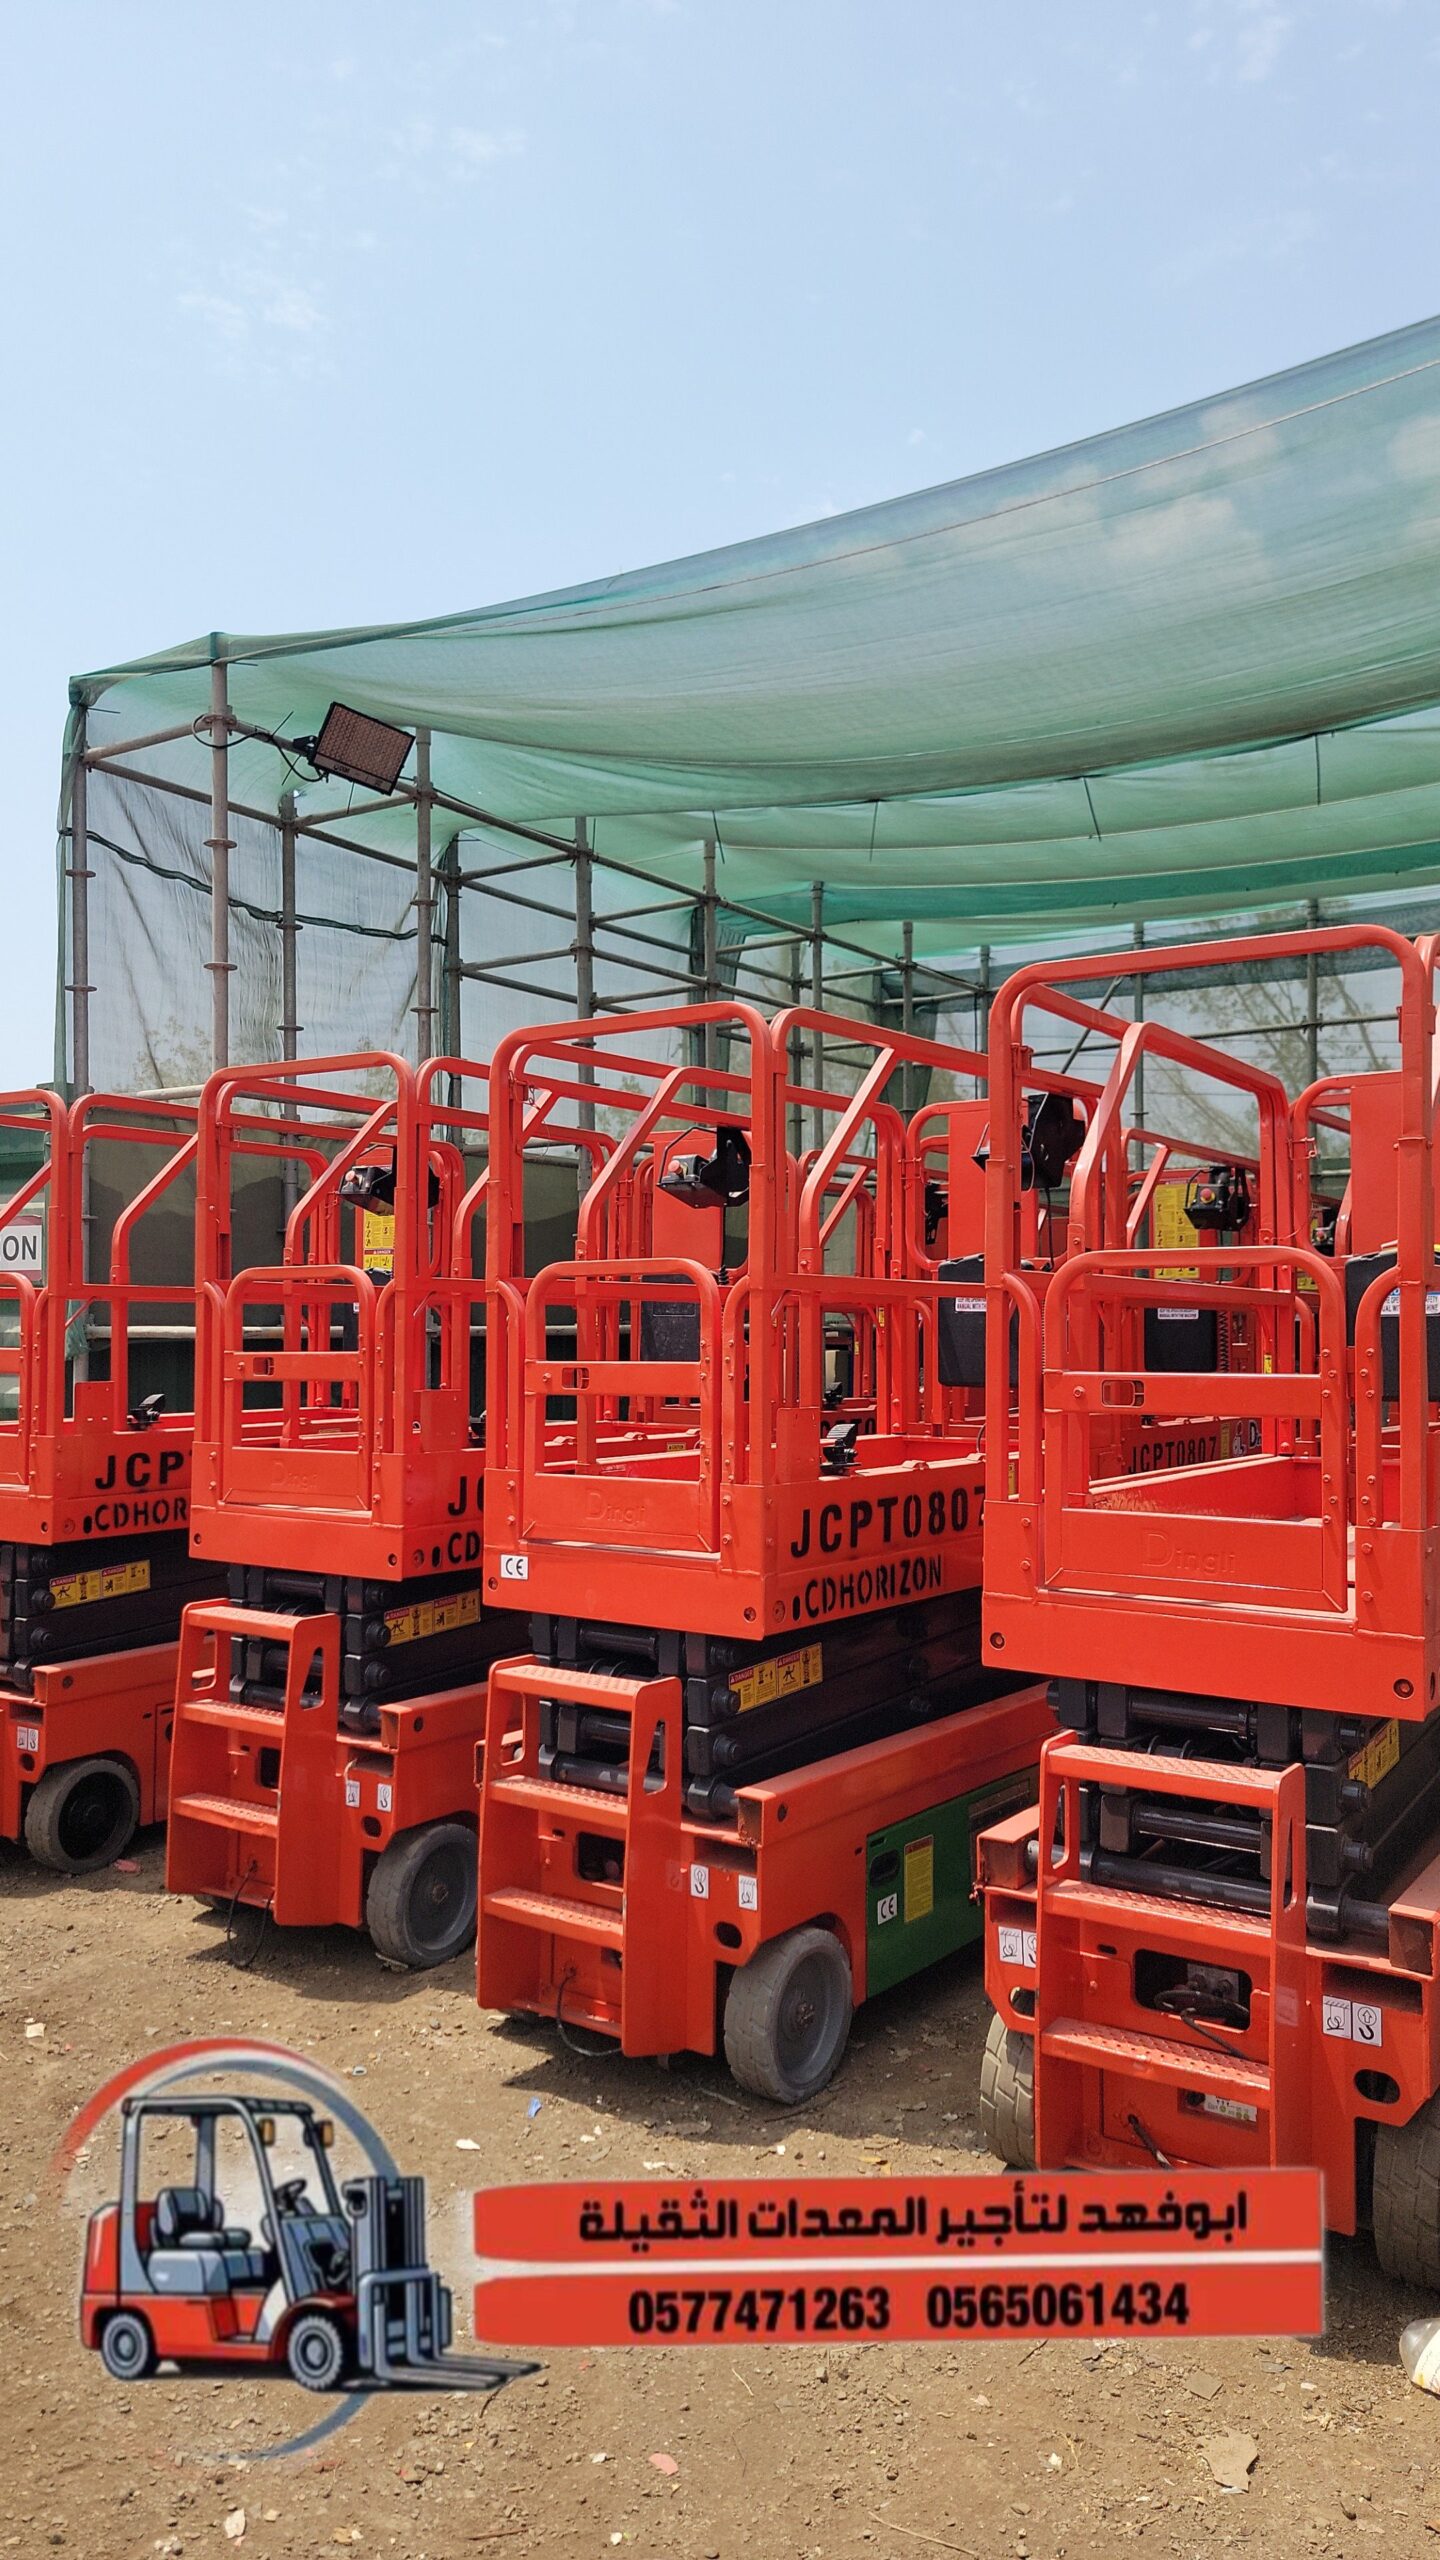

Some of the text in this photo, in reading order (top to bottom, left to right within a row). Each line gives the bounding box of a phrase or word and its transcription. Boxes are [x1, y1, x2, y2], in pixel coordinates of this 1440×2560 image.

[2, 1235, 37, 1262] ON
[95, 1450, 192, 1490] JCP
[1128, 1435, 1217, 1474] JCPT0807
[505, 1557, 524, 1577] CE
[804, 1553, 942, 1619] CDHORIZON
[880, 1896, 895, 1919] CE
